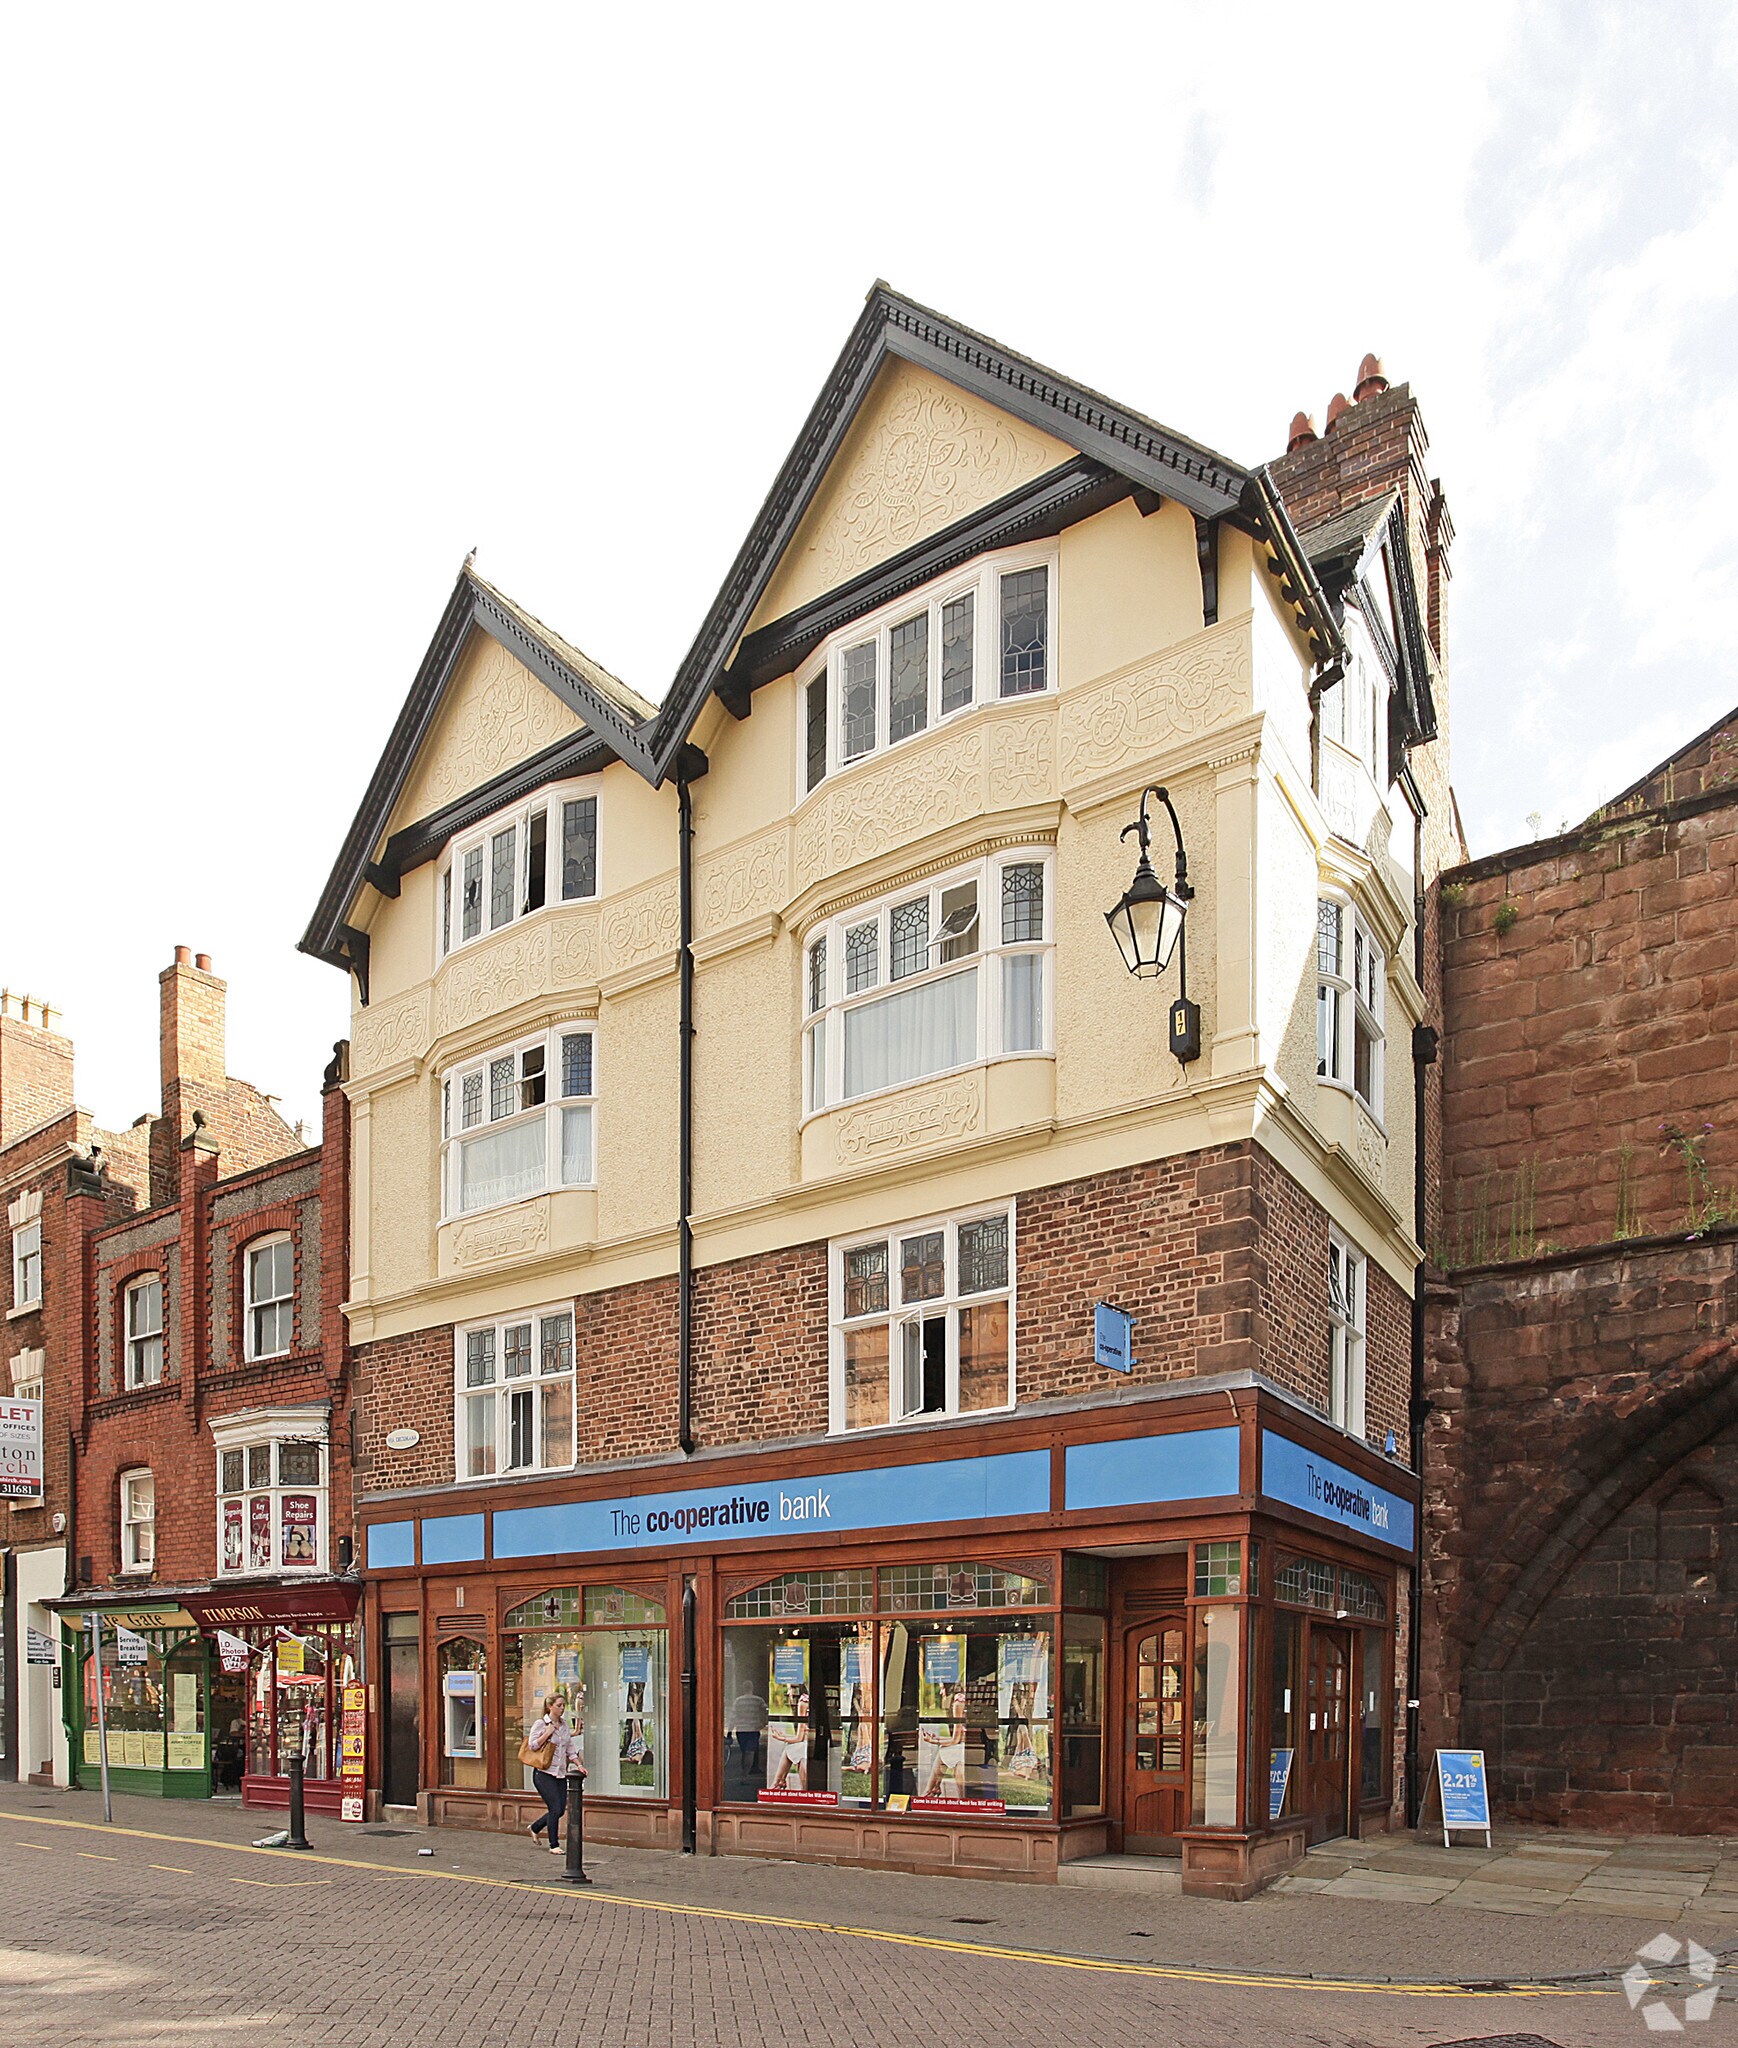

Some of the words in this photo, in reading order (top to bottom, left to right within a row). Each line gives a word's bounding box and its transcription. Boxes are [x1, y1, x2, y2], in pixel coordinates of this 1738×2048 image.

[0, 1406, 34, 1421] LET
[3, 1423, 36, 1431] OFFICES
[10, 1432, 31, 1440] SIZES
[2, 1484, 32, 1494] 311681
[1306, 1464, 1321, 1500] The
[1372, 1496, 1389, 1530] bank
[256, 1503, 265, 1512] Key
[290, 1501, 309, 1509] Shoe
[252, 1512, 270, 1521] Cutting
[285, 1511, 313, 1521] Repairs
[610, 1509, 640, 1536] The
[779, 1488, 831, 1521] bank
[202, 1606, 265, 1621] TIMPSON
[127, 1613, 166, 1626] Gate
[119, 1636, 139, 1644] Serving
[129, 1653, 139, 1661] day
